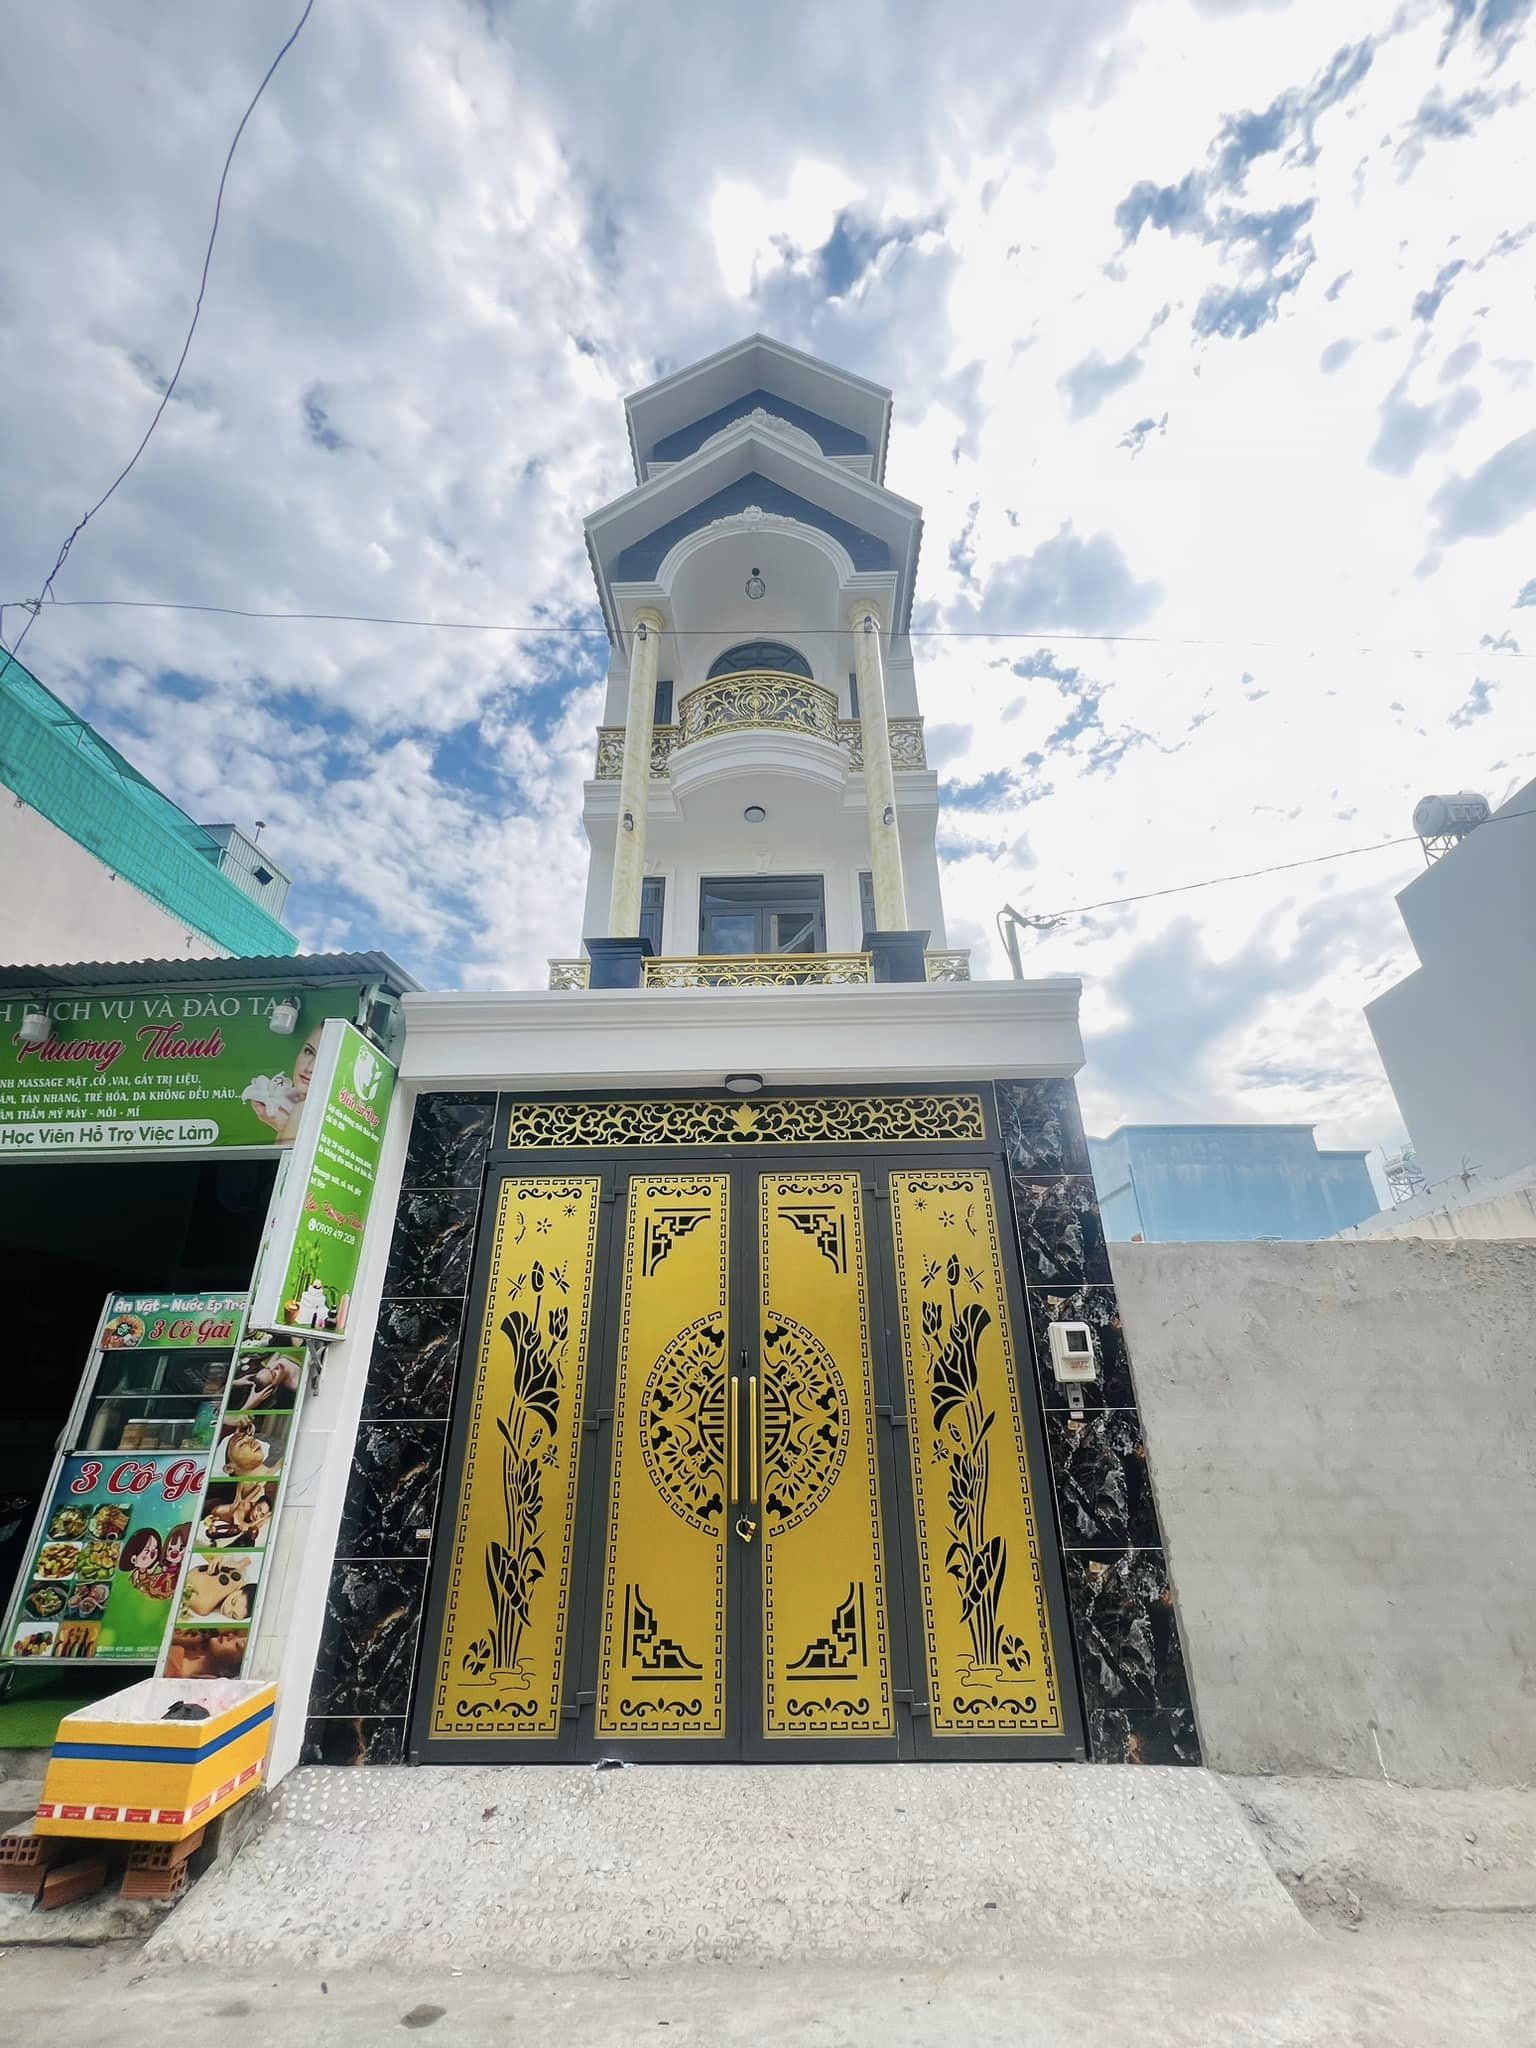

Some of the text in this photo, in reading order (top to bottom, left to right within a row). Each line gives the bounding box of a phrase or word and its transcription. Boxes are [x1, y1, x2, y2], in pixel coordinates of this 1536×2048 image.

[100, 1000, 136, 1023] VỤ
[143, 995, 174, 1018] VÀ
[183, 993, 240, 1017] ĐÀO
[136, 1020, 225, 1062] Thanh
[17, 1077, 64, 1088] MASSAGE
[66, 1075, 88, 1089] MẶT
[134, 1073, 154, 1085] GÁY
[156, 1074, 173, 1087] TRỊ
[132, 1091, 147, 1101] DA
[149, 1088, 186, 1101] KHÔNG
[16, 1106, 46, 1120] THẨM
[96, 1106, 117, 1118] MÔI
[126, 1105, 141, 1117] MÍ
[1, 1124, 213, 1147] Học Viên Hỗ Trợ Việc Làm
[149, 1319, 233, 1344] 3 Cô Gái
[70, 1460, 103, 1494] 3
[106, 1460, 161, 1495] Cô
